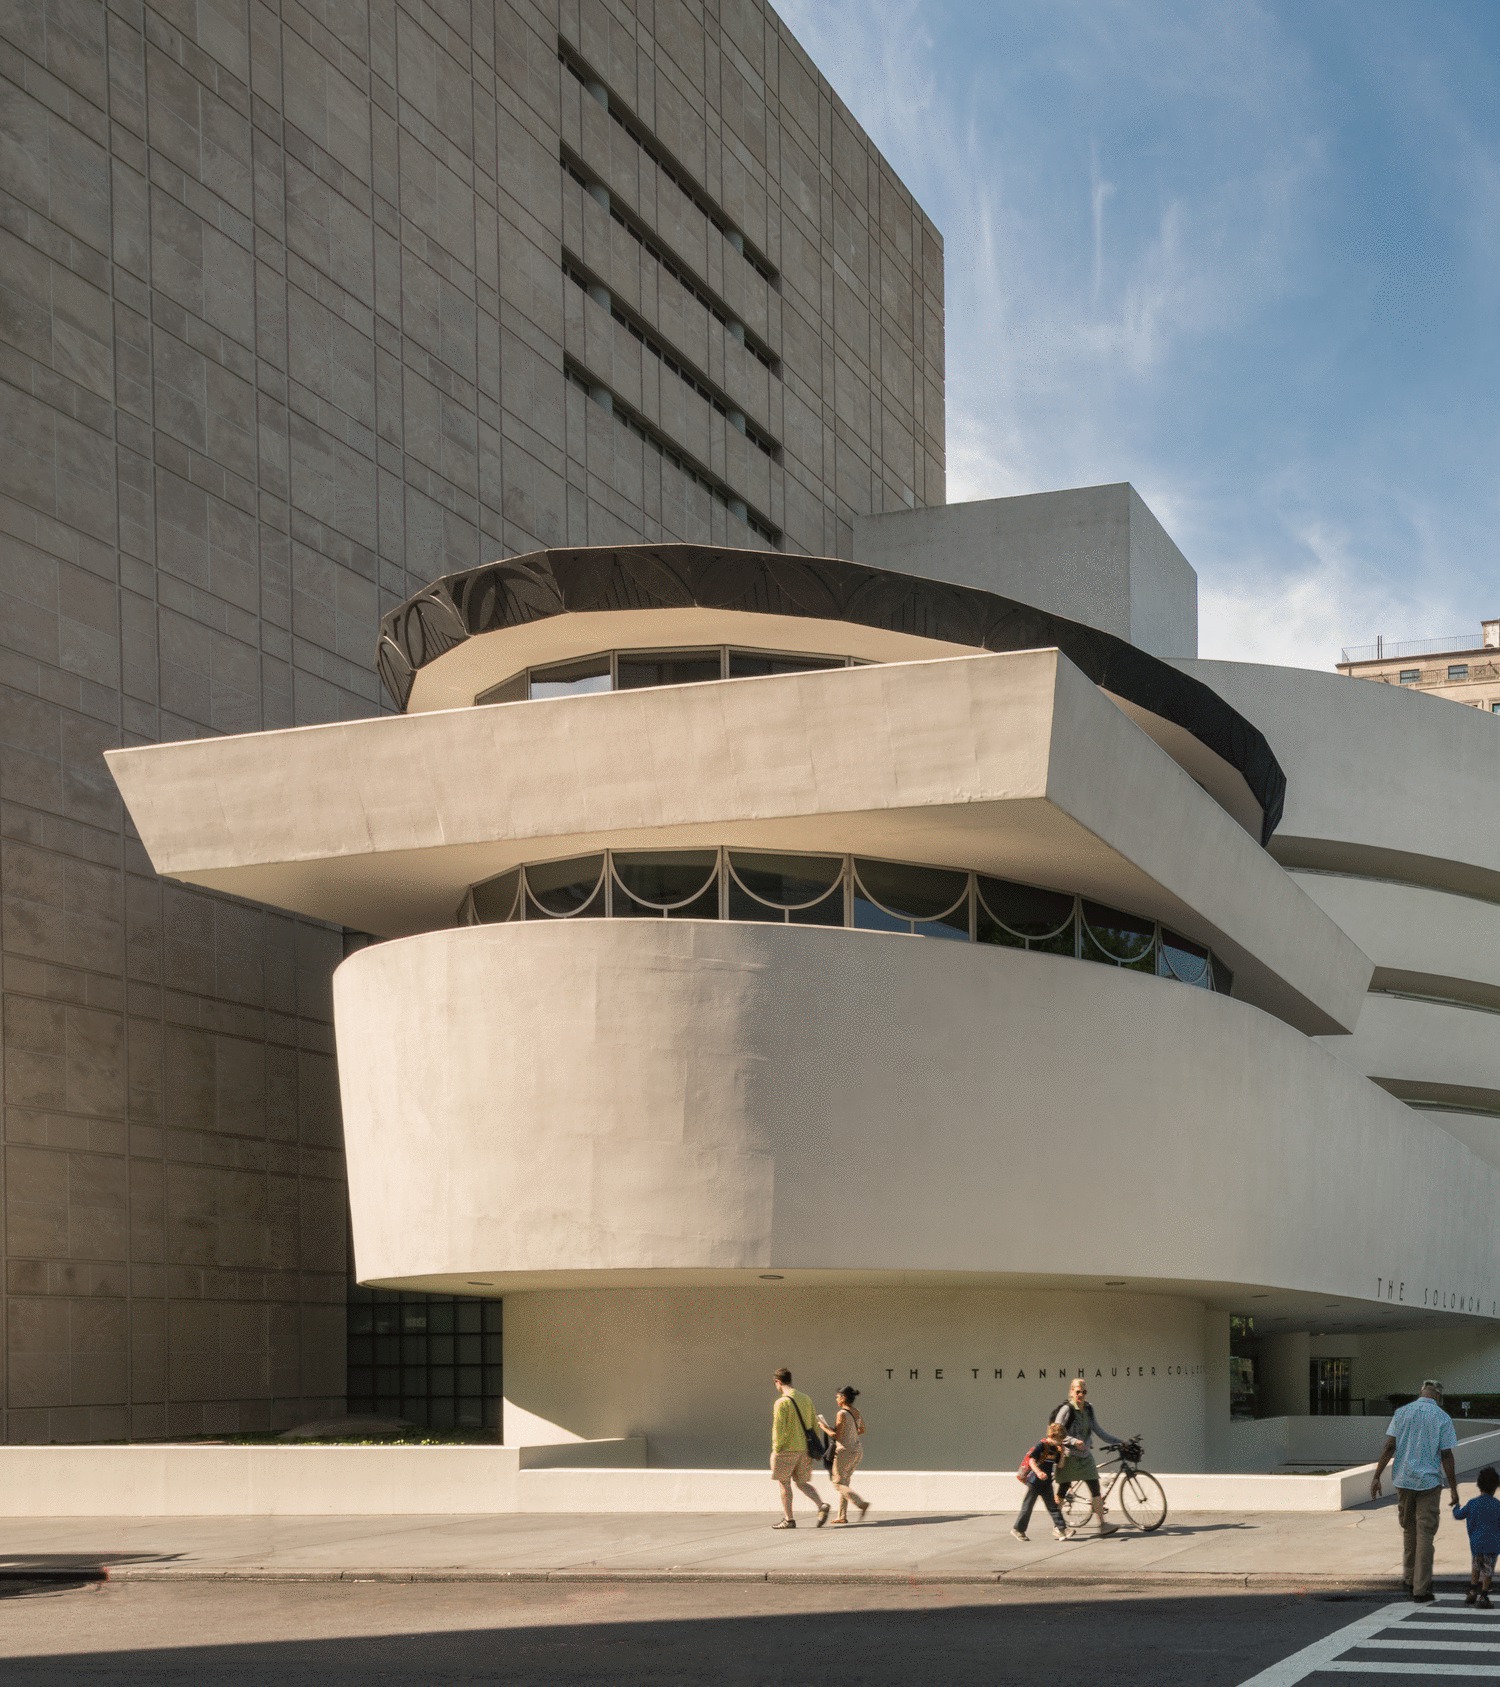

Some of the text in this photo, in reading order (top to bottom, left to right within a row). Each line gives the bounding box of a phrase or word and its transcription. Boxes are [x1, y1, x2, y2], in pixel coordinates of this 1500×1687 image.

[1377, 1277, 1405, 1301] THE
[1424, 1287, 1480, 1312] SOLOMON
[885, 1368, 944, 1380] THE
[971, 1367, 1156, 1379] THANNHAUSER
